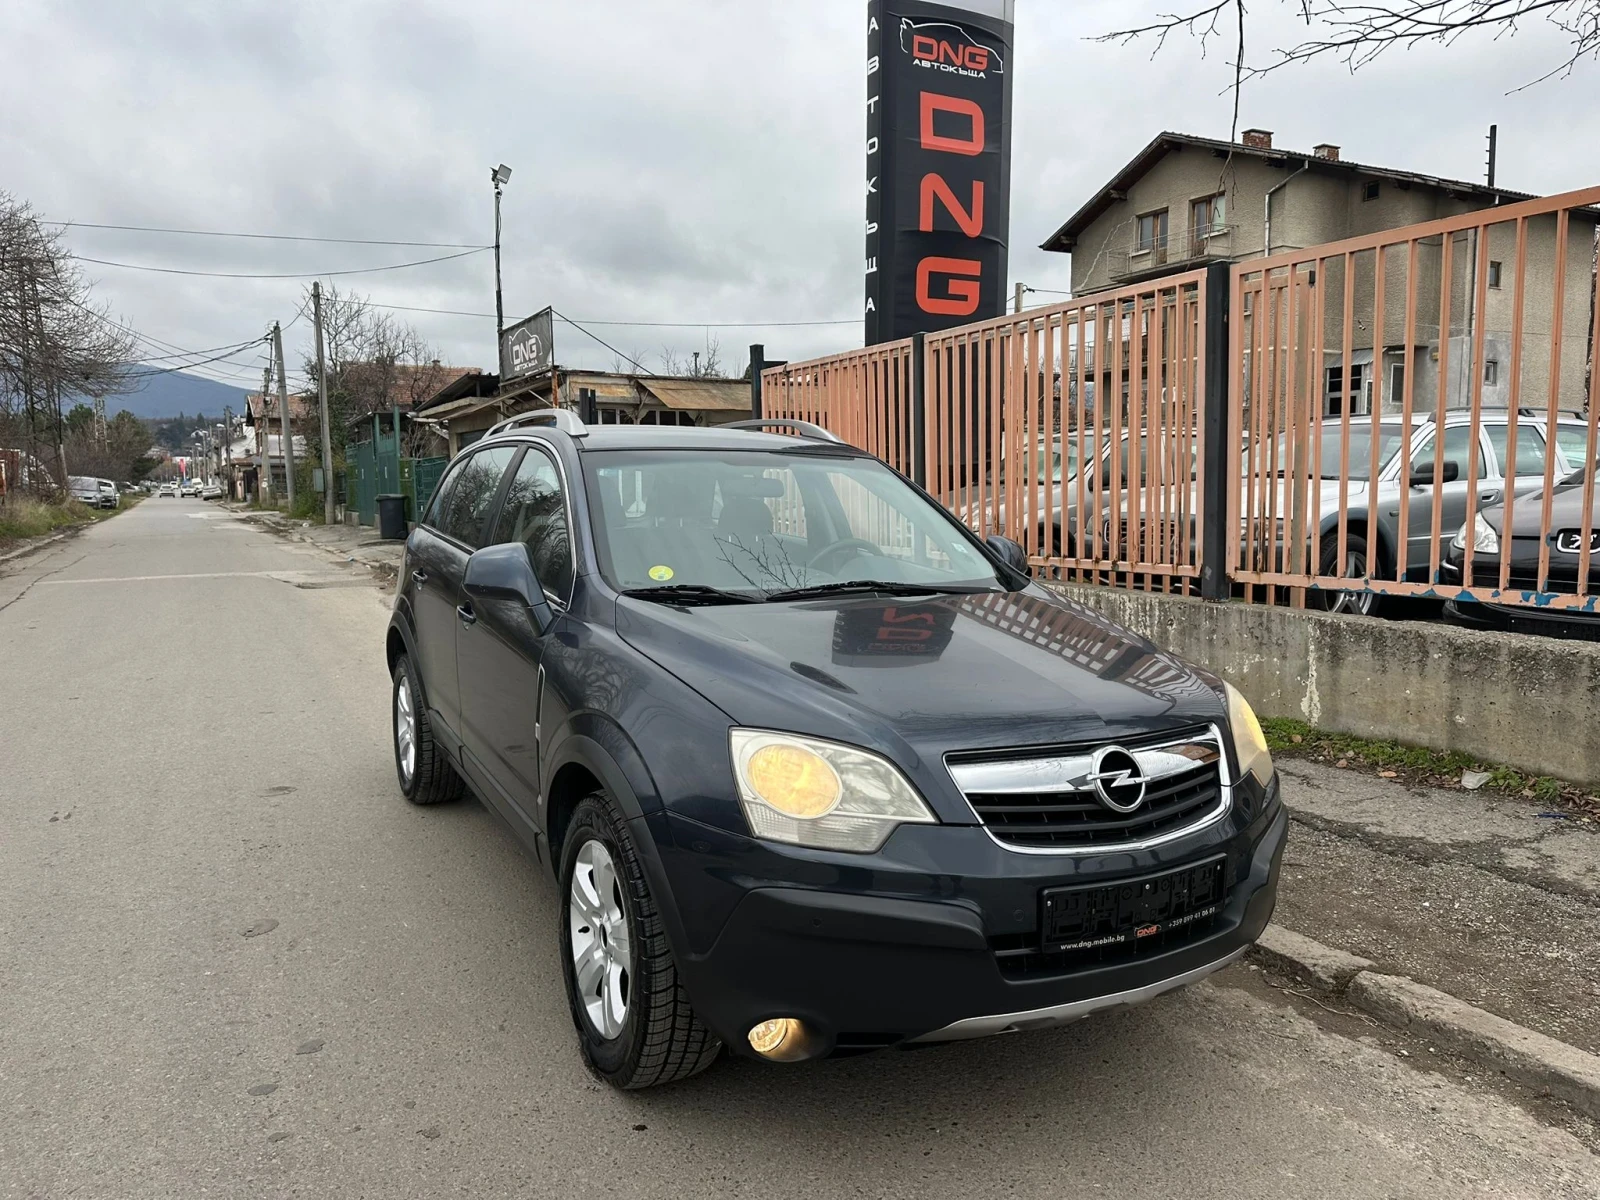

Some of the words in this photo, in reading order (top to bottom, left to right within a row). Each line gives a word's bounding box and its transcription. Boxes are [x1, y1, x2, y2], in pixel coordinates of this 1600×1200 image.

[912, 34, 988, 72] DNG
[912, 58, 987, 79] АВТОКЪЩА
[915, 90, 985, 316] DNG
[513, 338, 537, 365] DNG
[1136, 924, 1158, 937] DNG
[1168, 918, 1183, 928] +359
[1060, 934, 1125, 950] www.dng.mobile.bg
